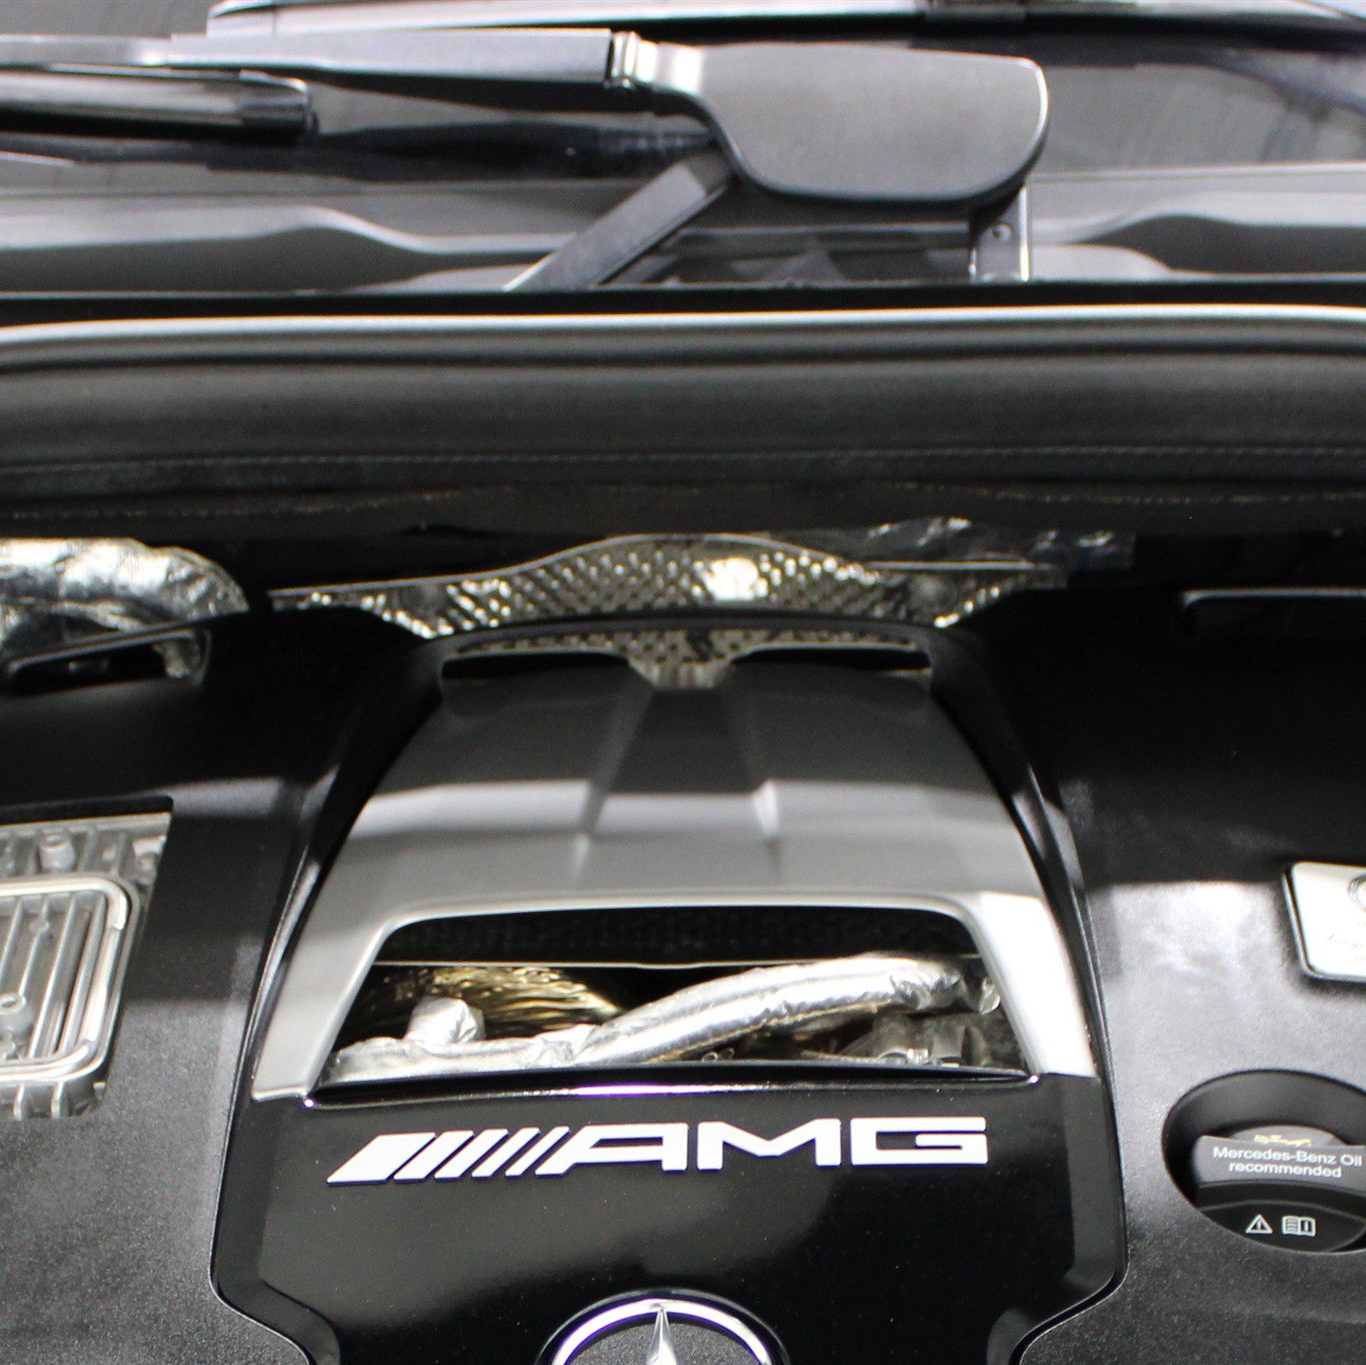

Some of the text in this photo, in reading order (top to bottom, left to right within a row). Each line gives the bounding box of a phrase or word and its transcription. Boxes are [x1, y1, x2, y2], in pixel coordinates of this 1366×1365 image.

[535, 1117, 988, 1176] AMG
[1212, 1146, 1363, 1167] Mercedes-Benz Oil
[1228, 1161, 1342, 1178] recommended
